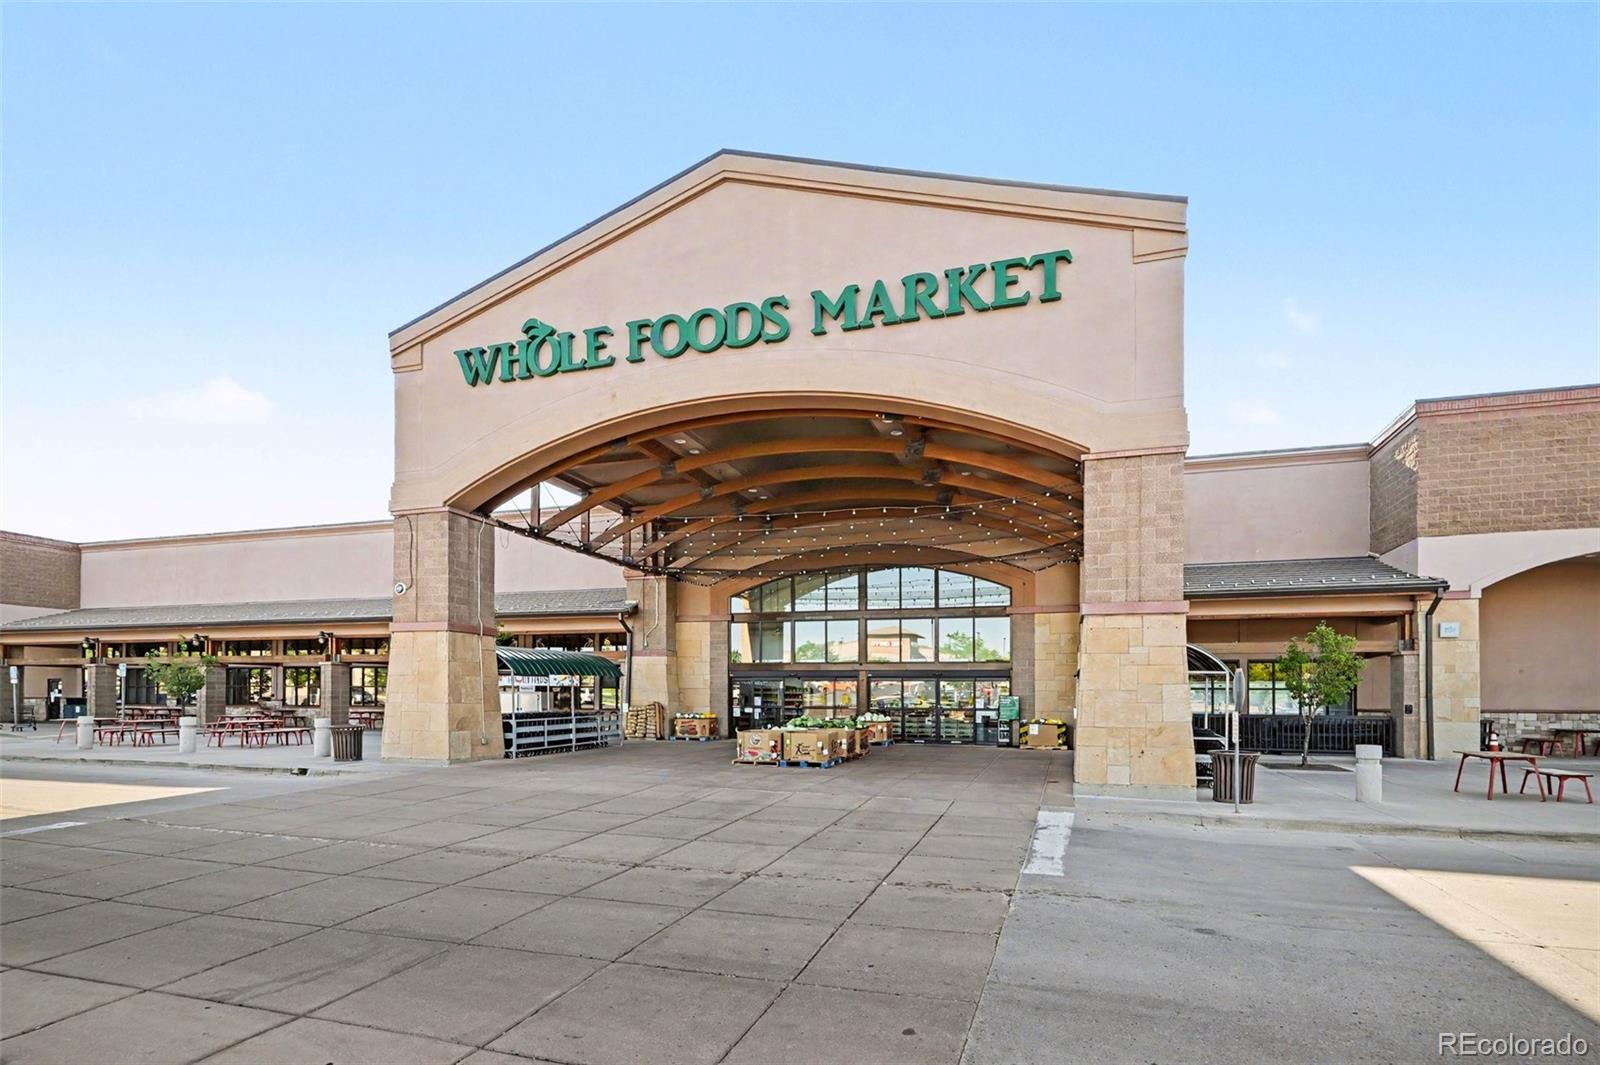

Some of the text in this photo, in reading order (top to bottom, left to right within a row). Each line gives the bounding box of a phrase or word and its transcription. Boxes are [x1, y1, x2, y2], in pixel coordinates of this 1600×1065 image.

[455, 249, 1073, 387] WHOLE FOODS MARKET
